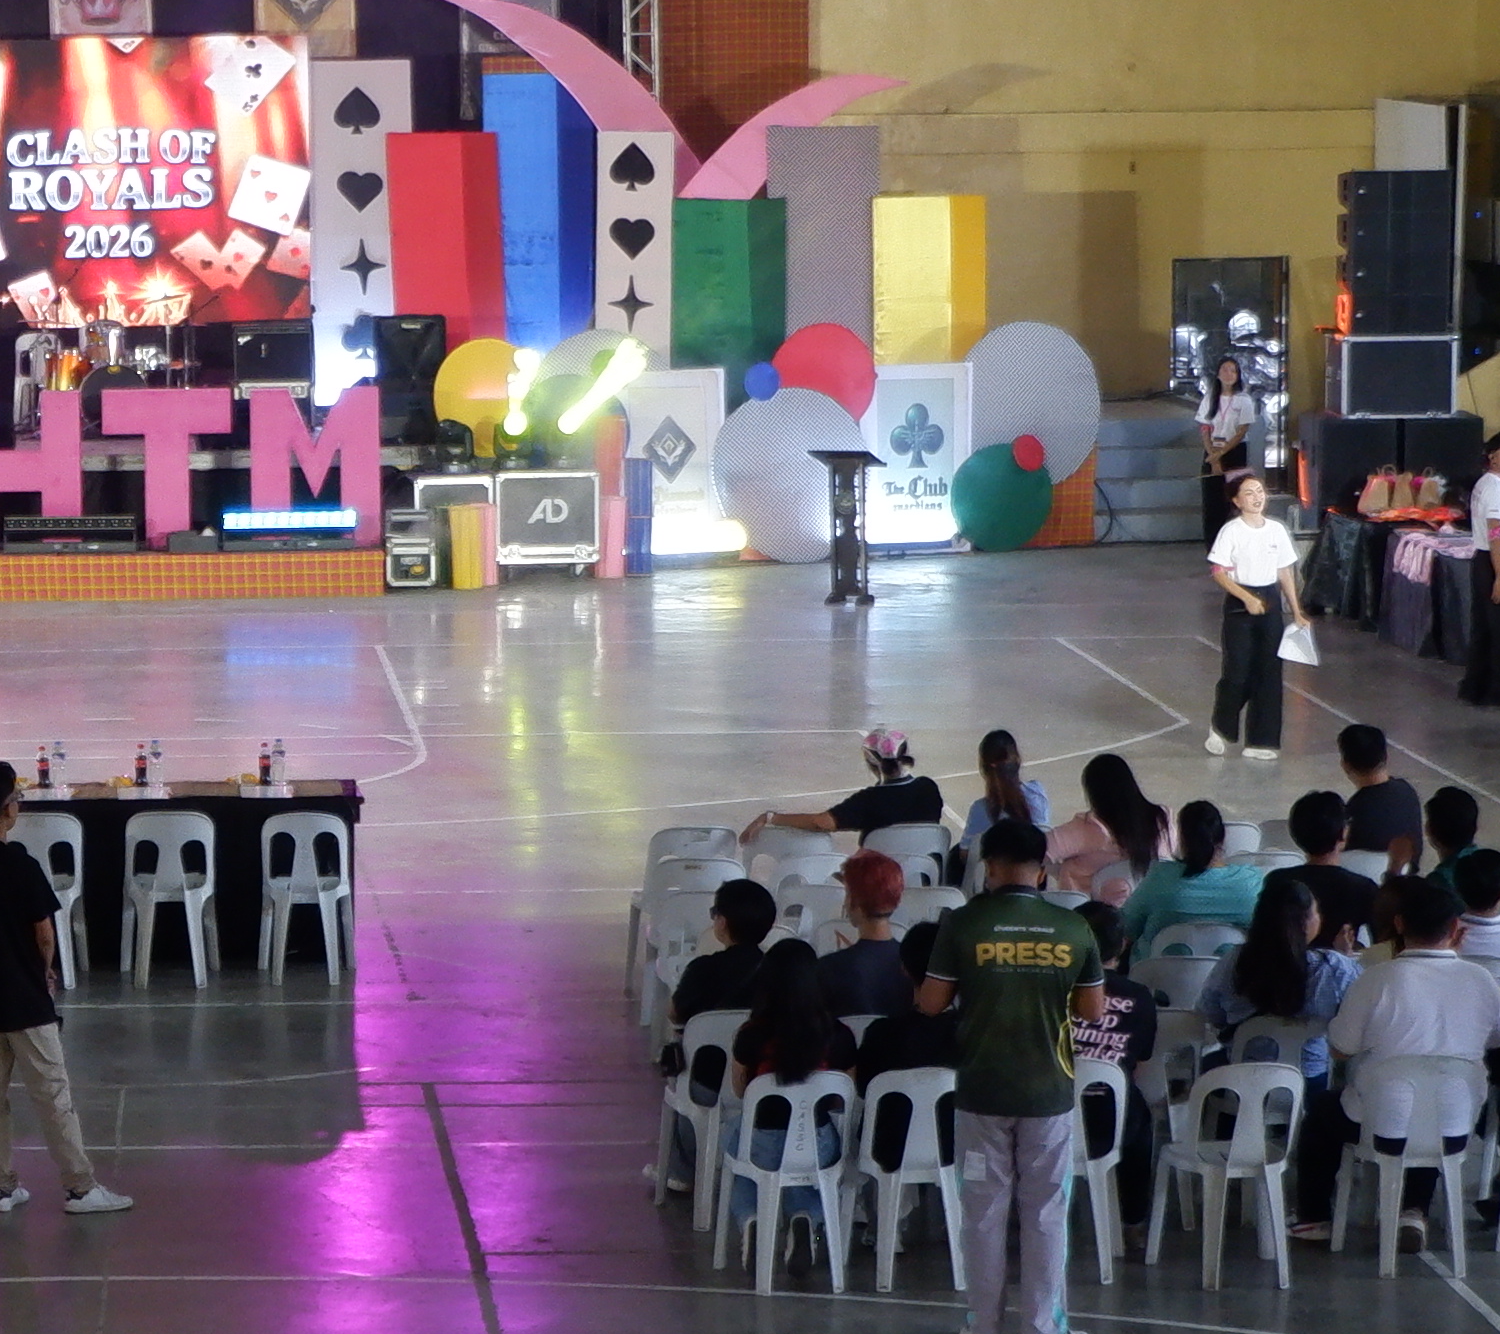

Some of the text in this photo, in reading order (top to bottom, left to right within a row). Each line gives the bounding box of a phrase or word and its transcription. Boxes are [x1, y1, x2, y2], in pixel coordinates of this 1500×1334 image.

[6, 128, 217, 167] CLASH OF
[7, 167, 215, 212] ROYALS
[64, 224, 155, 259] 2026
[905, 474, 949, 500] Club
[975, 941, 1073, 968] PRESS
